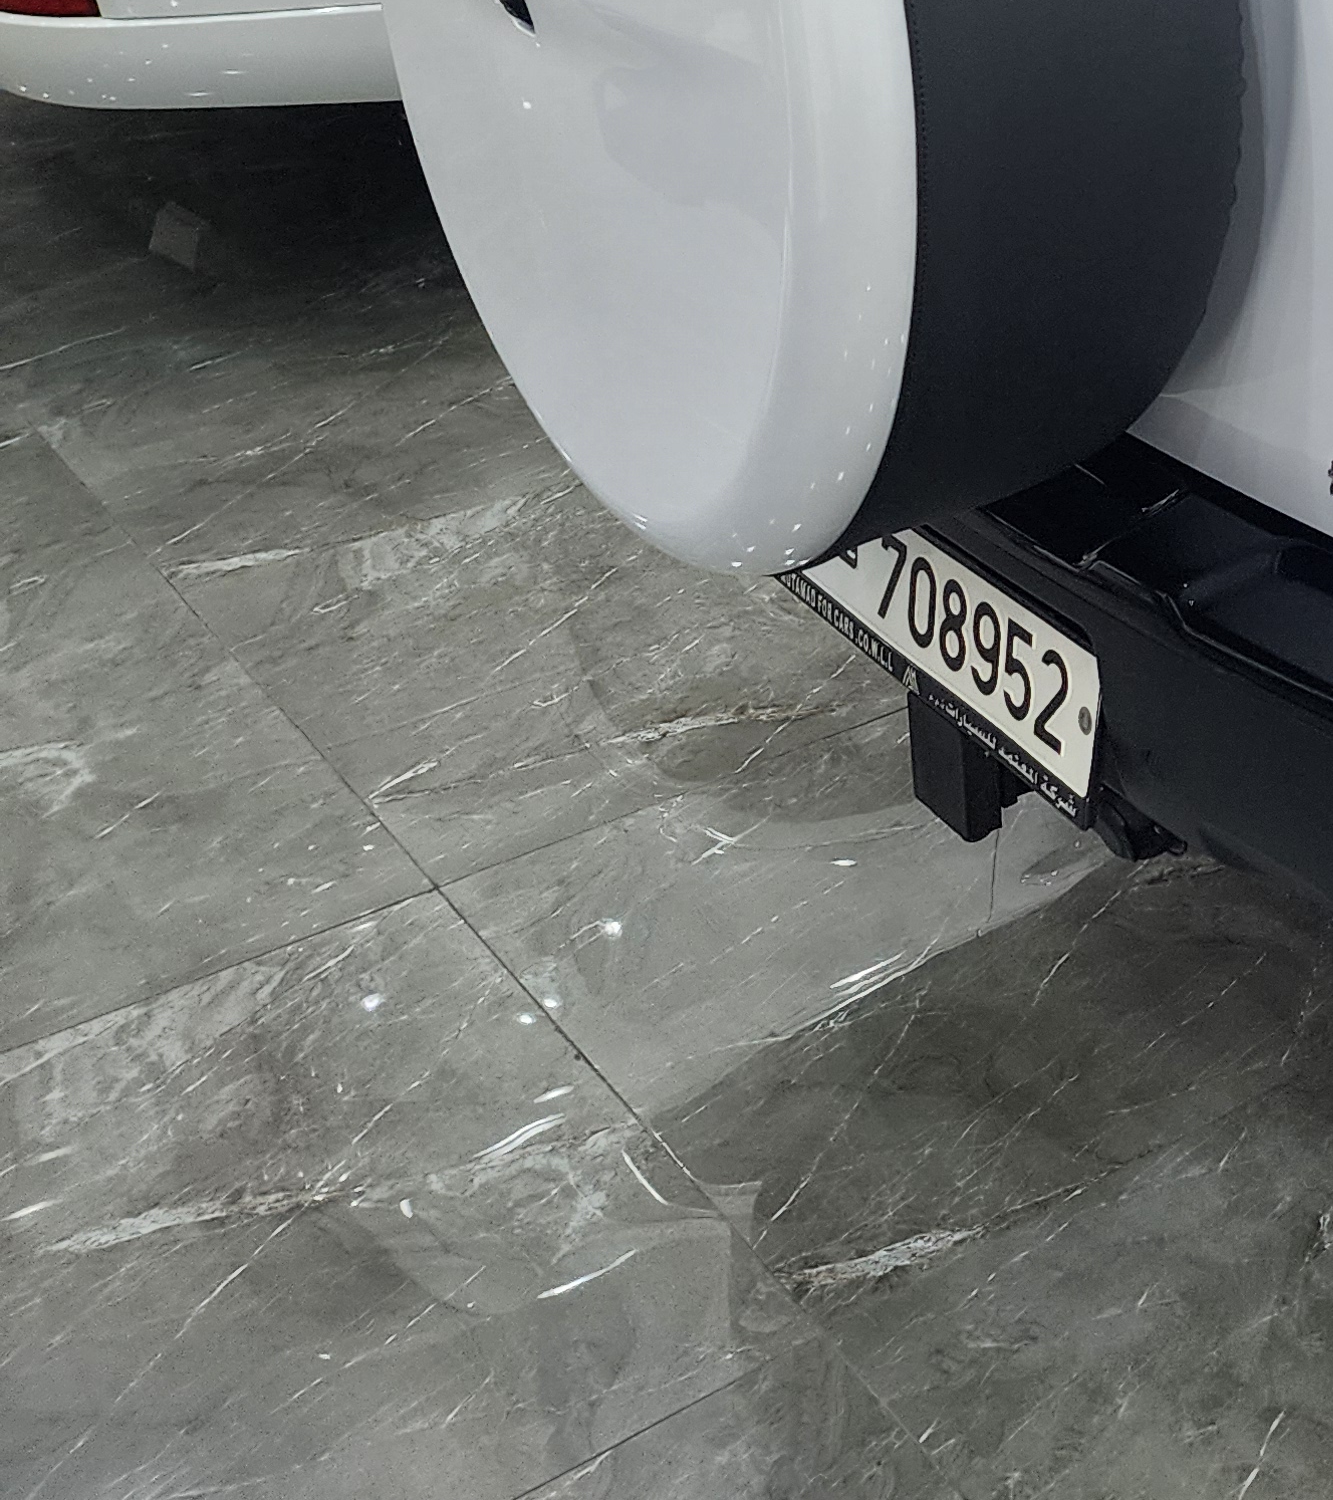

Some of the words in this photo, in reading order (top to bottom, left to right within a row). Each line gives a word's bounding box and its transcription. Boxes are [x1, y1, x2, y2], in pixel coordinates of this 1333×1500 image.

[817, 594, 832, 623] FOR
[834, 609, 854, 640] CARS
[877, 533, 1069, 756] 708952
[945, 702, 997, 750] للسيارات
[1040, 774, 1078, 817] شركة
